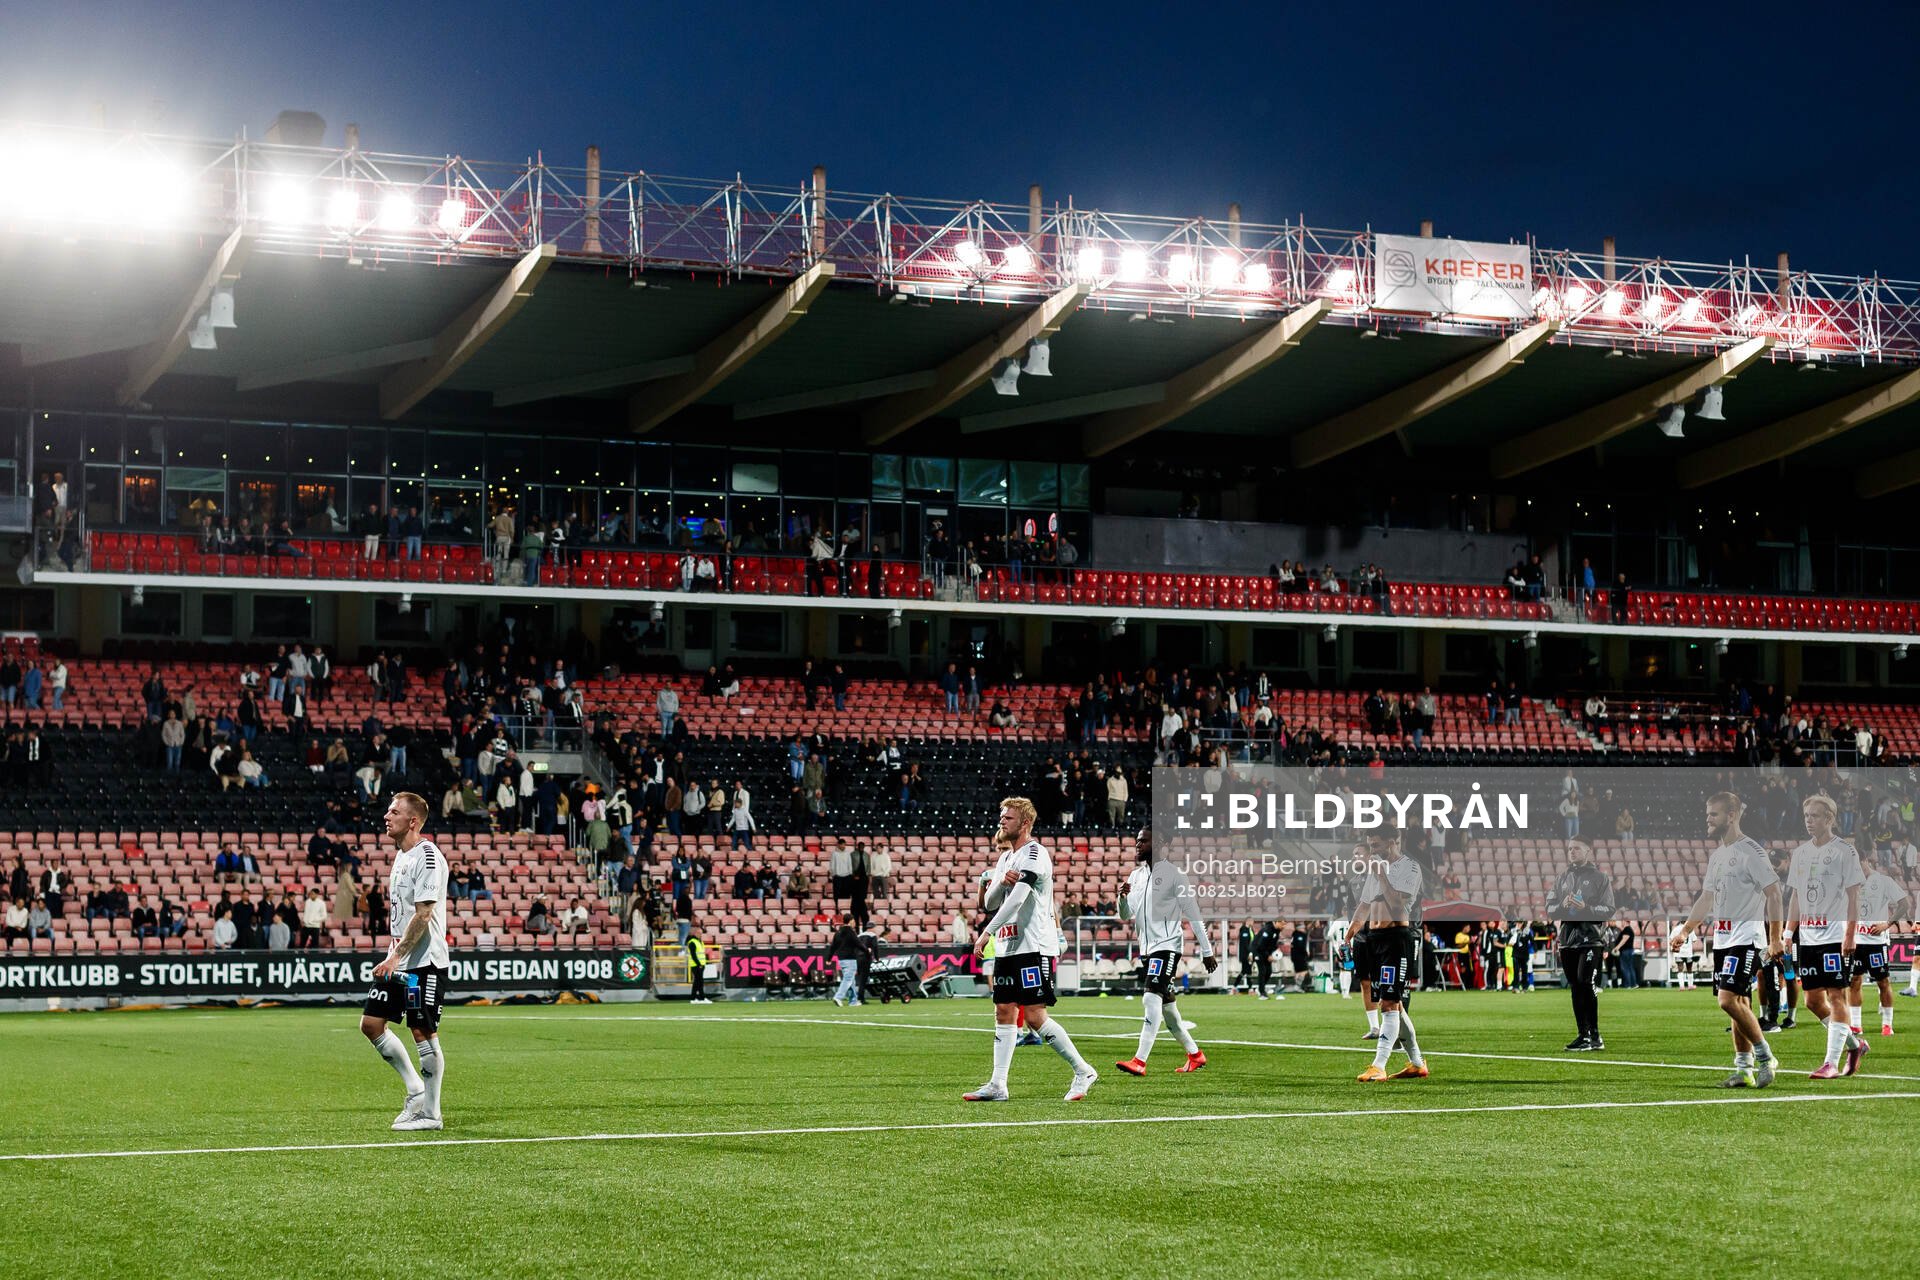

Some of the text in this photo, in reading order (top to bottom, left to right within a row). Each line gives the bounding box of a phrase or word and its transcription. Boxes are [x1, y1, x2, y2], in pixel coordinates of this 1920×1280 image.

[1425, 258, 1524, 280] KAEFER
[140, 962, 263, 988] STOLTHET,
[268, 958, 355, 989] HJÄRTA
[485, 960, 559, 980] SEDAN
[564, 959, 614, 980] 1908
